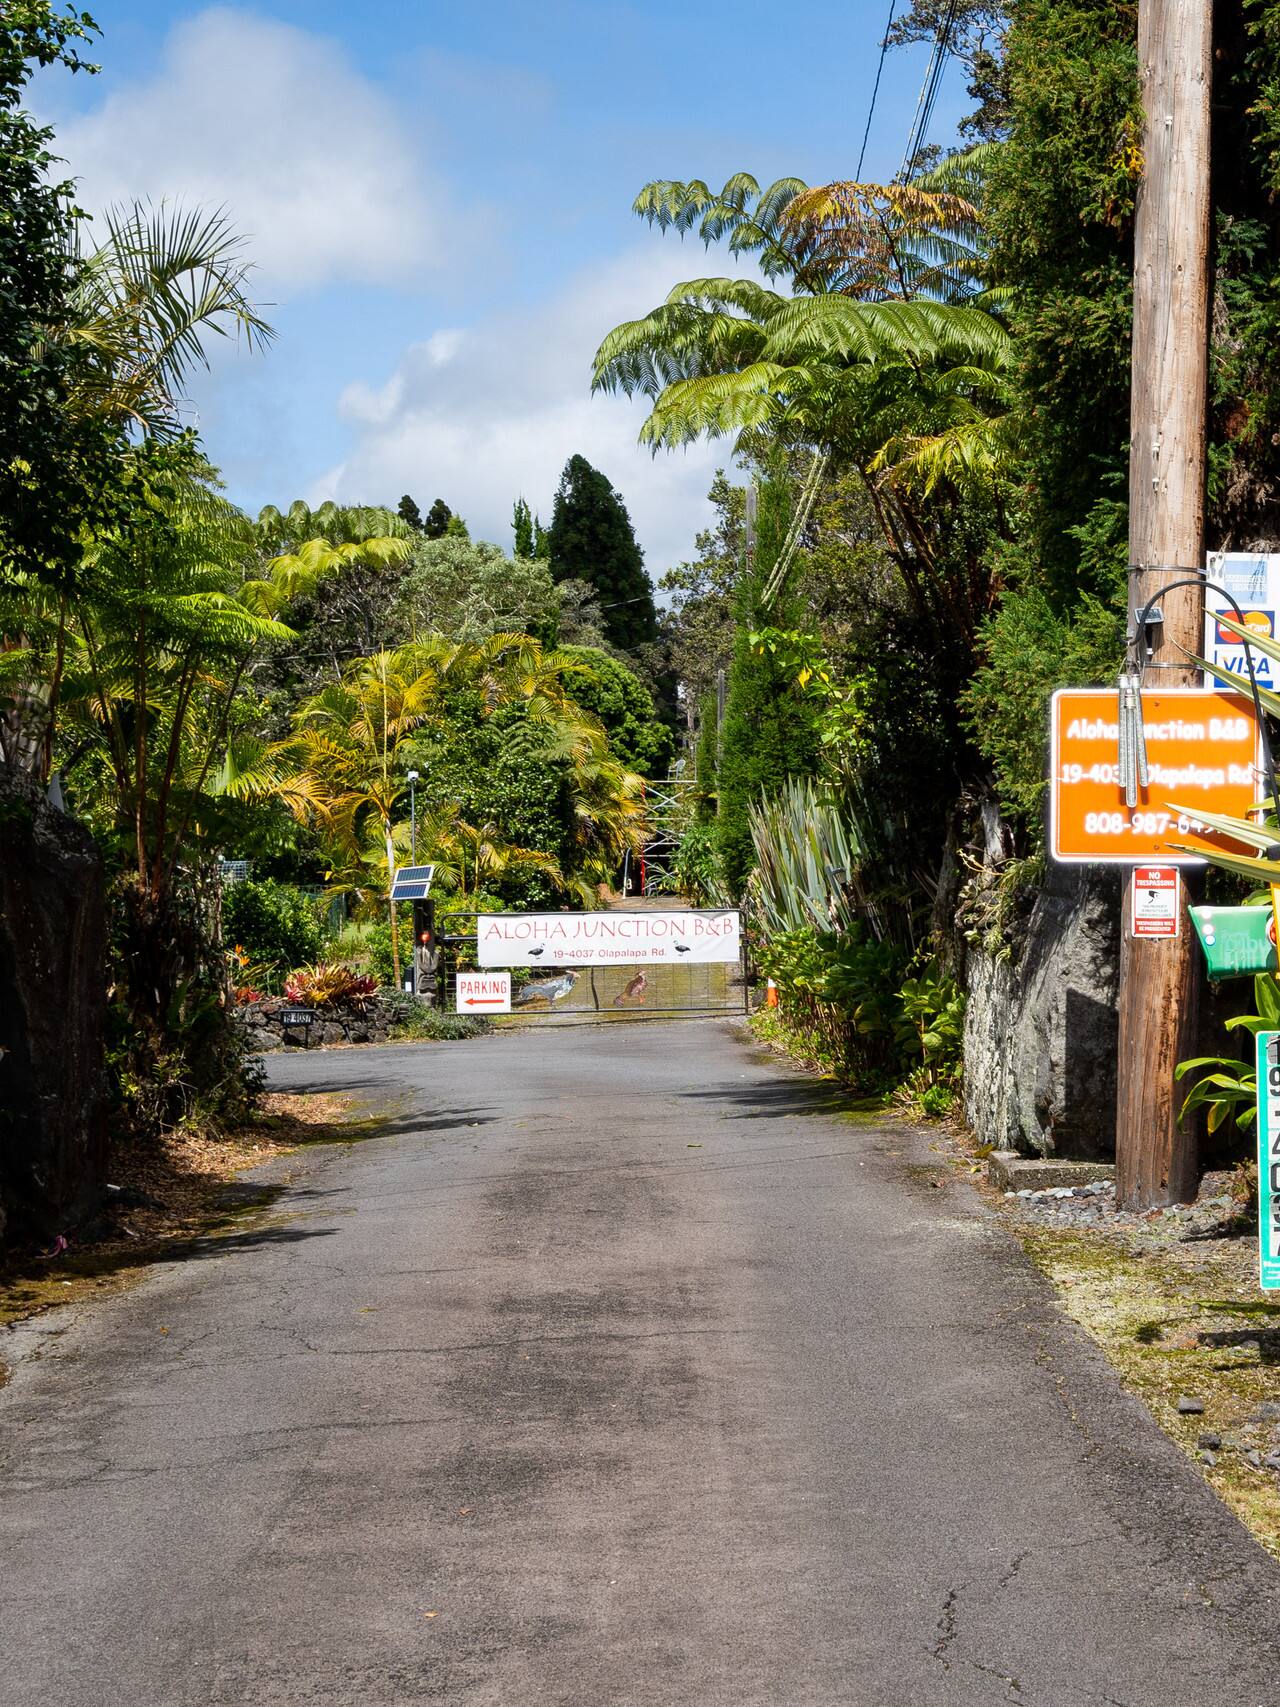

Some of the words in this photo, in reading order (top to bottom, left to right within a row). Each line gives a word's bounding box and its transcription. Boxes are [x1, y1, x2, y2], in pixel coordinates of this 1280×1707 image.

[1222, 656, 1270, 674] VISA
[1067, 718, 1119, 740] Aloha
[1144, 719, 1205, 740] nction
[1208, 718, 1249, 741] B&B
[1062, 763, 1121, 785] 19-403
[485, 920, 568, 940] ALOHA
[572, 919, 686, 938] JUNCTION
[694, 917, 733, 936] B&B
[553, 949, 595, 959] 19-4037
[598, 948, 648, 960] Olapalapa
[651, 948, 667, 957] Rd.
[460, 980, 507, 994] PARKING
